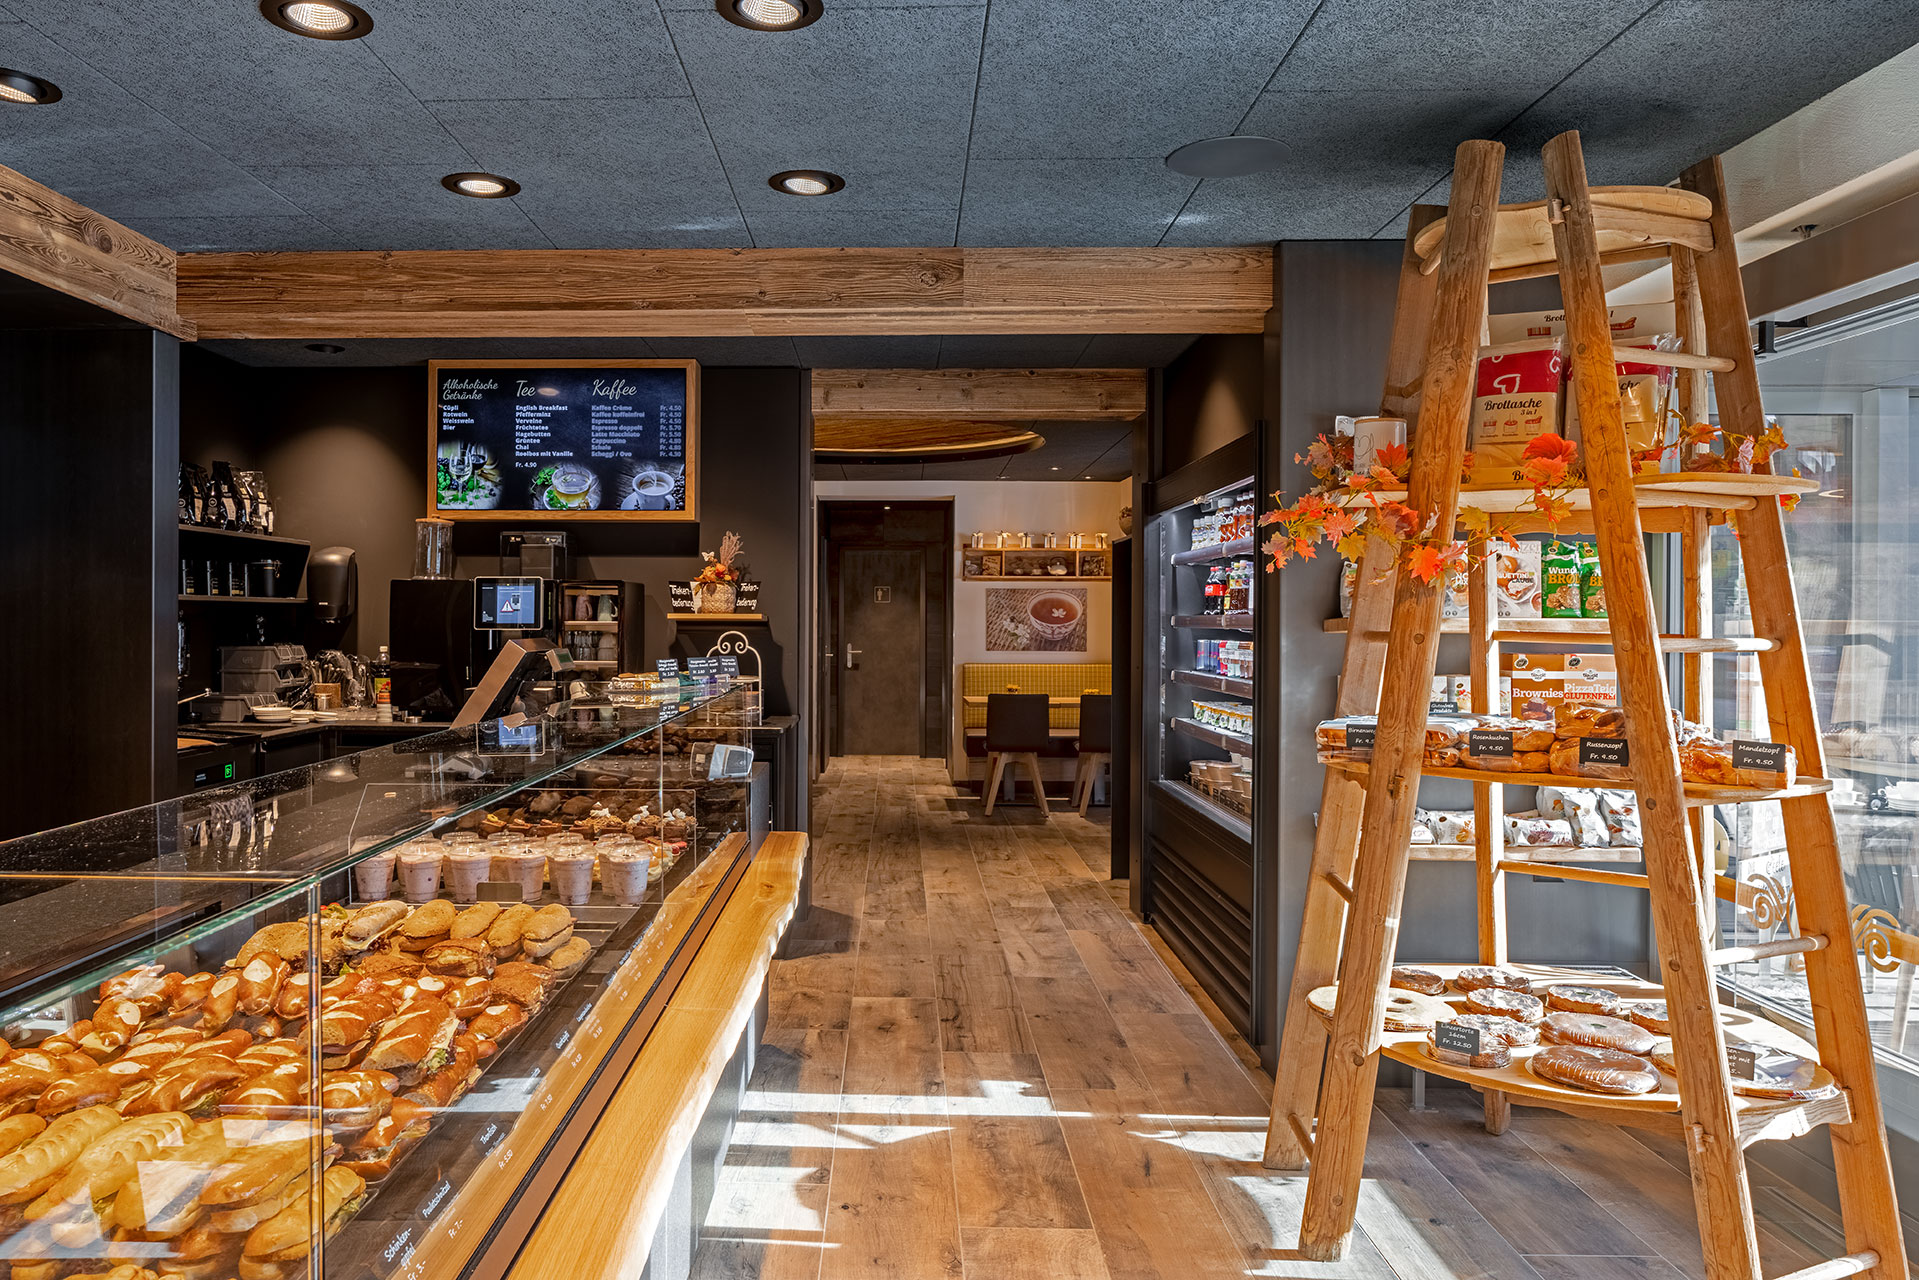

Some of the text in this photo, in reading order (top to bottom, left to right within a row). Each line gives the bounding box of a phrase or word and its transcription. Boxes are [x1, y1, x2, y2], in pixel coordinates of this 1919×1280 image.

[443, 379, 498, 390] Alkoholische
[516, 380, 536, 397] Tee
[592, 379, 637, 400] Kaffee
[442, 389, 482, 401] Getränke
[1484, 398, 1542, 411] Brottasche
[1548, 566, 1578, 574] Wund
[1512, 688, 1564, 698] Brownies
[1472, 734, 1510, 742] Rosenkuchen
[1586, 742, 1622, 750] Russenzopf
[1739, 745, 1780, 754] Mandelzopf
[1441, 1024, 1474, 1034] Linzertorte
[384, 1228, 412, 1262] Schinken-
